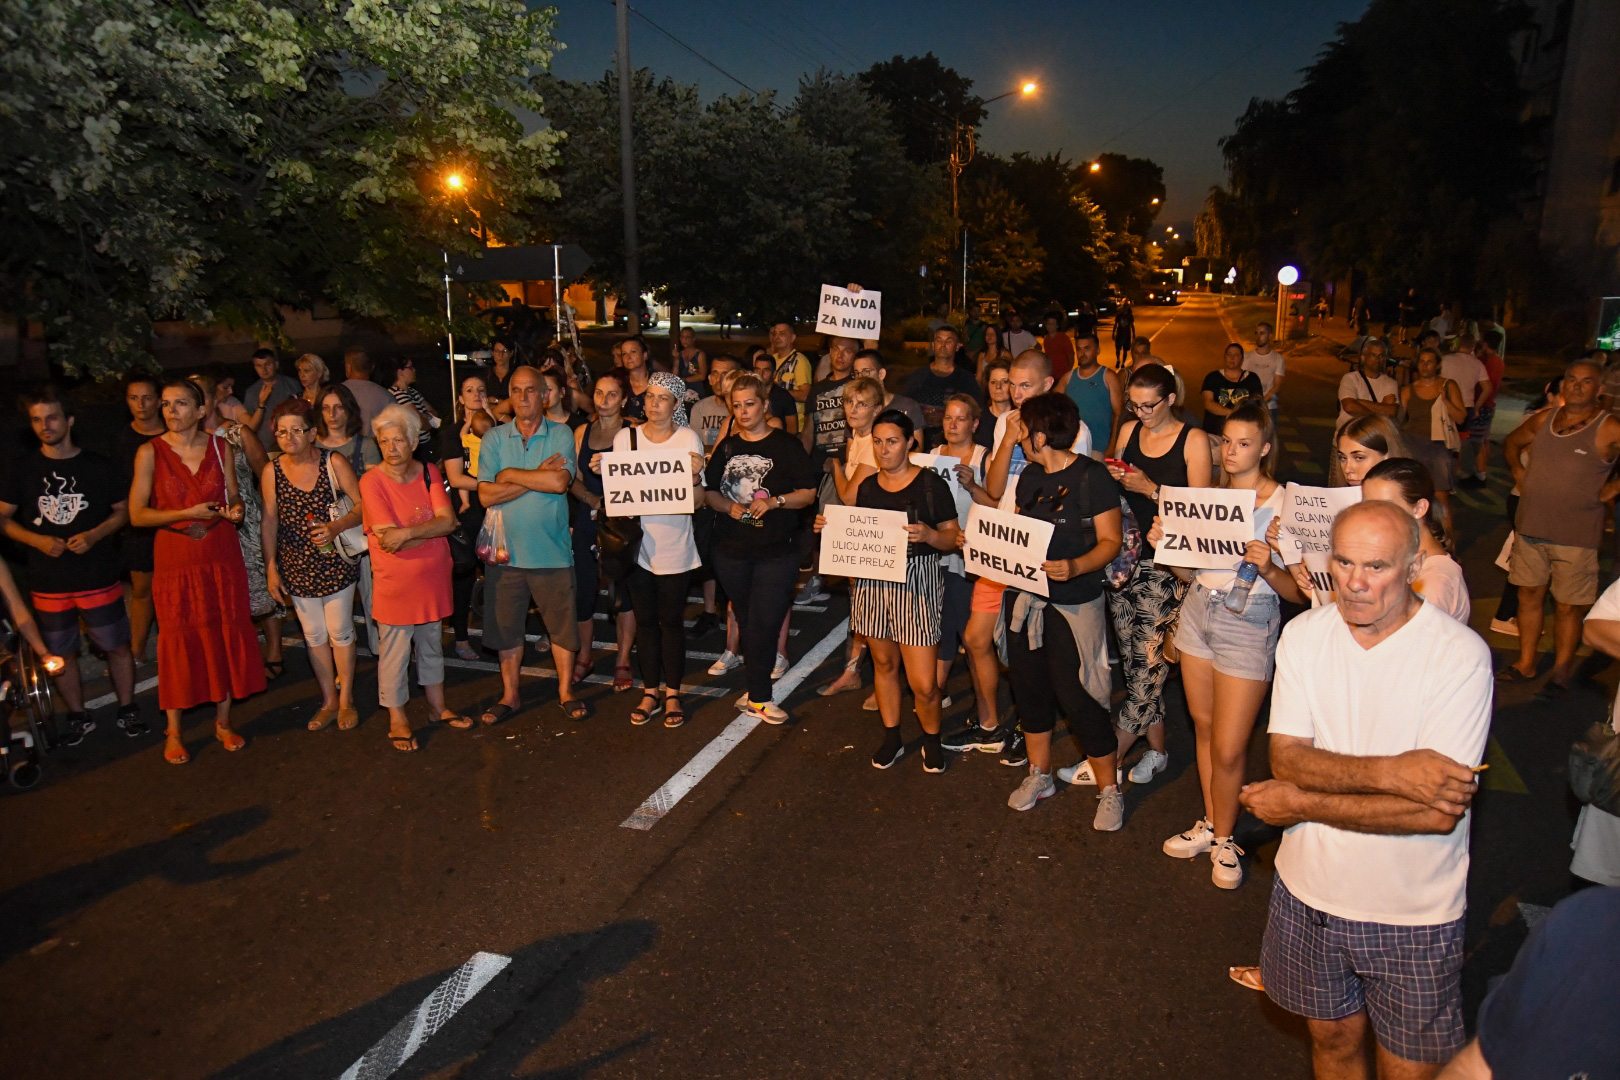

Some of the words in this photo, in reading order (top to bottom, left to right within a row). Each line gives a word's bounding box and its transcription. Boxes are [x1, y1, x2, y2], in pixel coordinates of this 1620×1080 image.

[824, 294, 877, 310] PRAVDA
[821, 314, 837, 326] ZA
[842, 318, 876, 330] NINU
[701, 415, 726, 429] NIK
[608, 460, 685, 477] PRAVDA
[610, 490, 635, 504] ZA
[640, 488, 687, 503] NINU
[1295, 495, 1328, 508] DAJTE
[1163, 500, 1245, 523] PRAVDA
[849, 515, 878, 525] DAJTE
[845, 527, 884, 539] GLAVNU
[979, 519, 1030, 548] NININ
[1285, 526, 1317, 538] ULICU
[832, 540, 860, 551] ULICU
[862, 543, 882, 553] AKO
[884, 545, 896, 555] NE
[1163, 533, 1192, 552] ZA
[1196, 537, 1248, 557] NINU
[1294, 540, 1322, 552] DTE
[832, 554, 856, 565] DATE
[859, 556, 895, 569] PRELAZ
[970, 548, 1038, 582] PRELAZ
